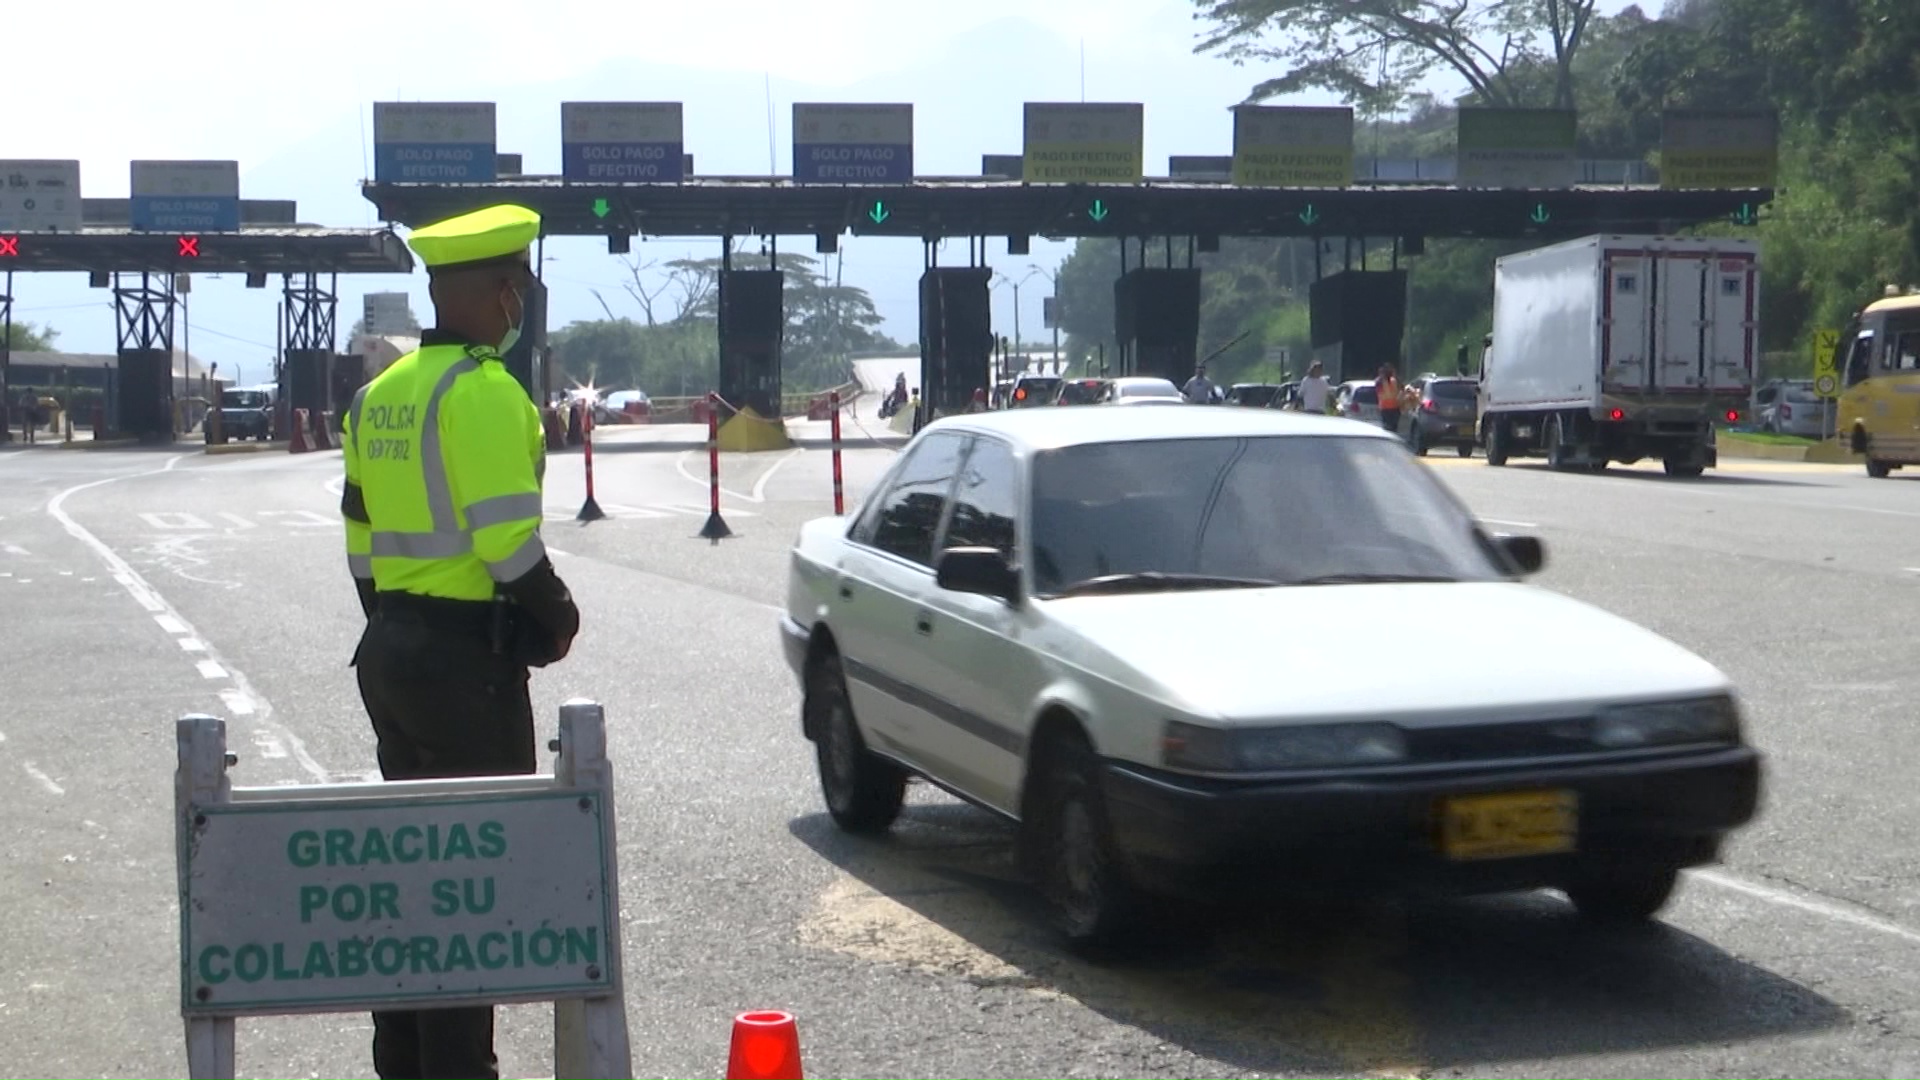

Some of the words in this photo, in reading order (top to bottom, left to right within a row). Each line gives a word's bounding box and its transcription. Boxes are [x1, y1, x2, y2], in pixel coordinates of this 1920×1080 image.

[395, 148, 433, 160] SOLO
[436, 148, 473, 160] PAGO
[582, 146, 621, 159] SOLO
[625, 146, 665, 159] PAGO
[811, 147, 850, 160] SOLO
[854, 147, 894, 160] PAGO
[1033, 151, 1067, 161] PAGO
[1071, 151, 1132, 161] EFECTIVO
[1281, 154, 1343, 166] EFECTIVO
[402, 164, 467, 177] EFECTIVO
[588, 163, 657, 177] EFECTIVO
[817, 164, 887, 178] EFECTIVO
[185, 200, 219, 212] PAGO
[155, 215, 214, 225] EFECTIVO
[286, 821, 508, 868] GRACIAS
[299, 880, 401, 923] POR
[431, 876, 496, 917] SU
[198, 918, 599, 984] COLABORACIÓN
